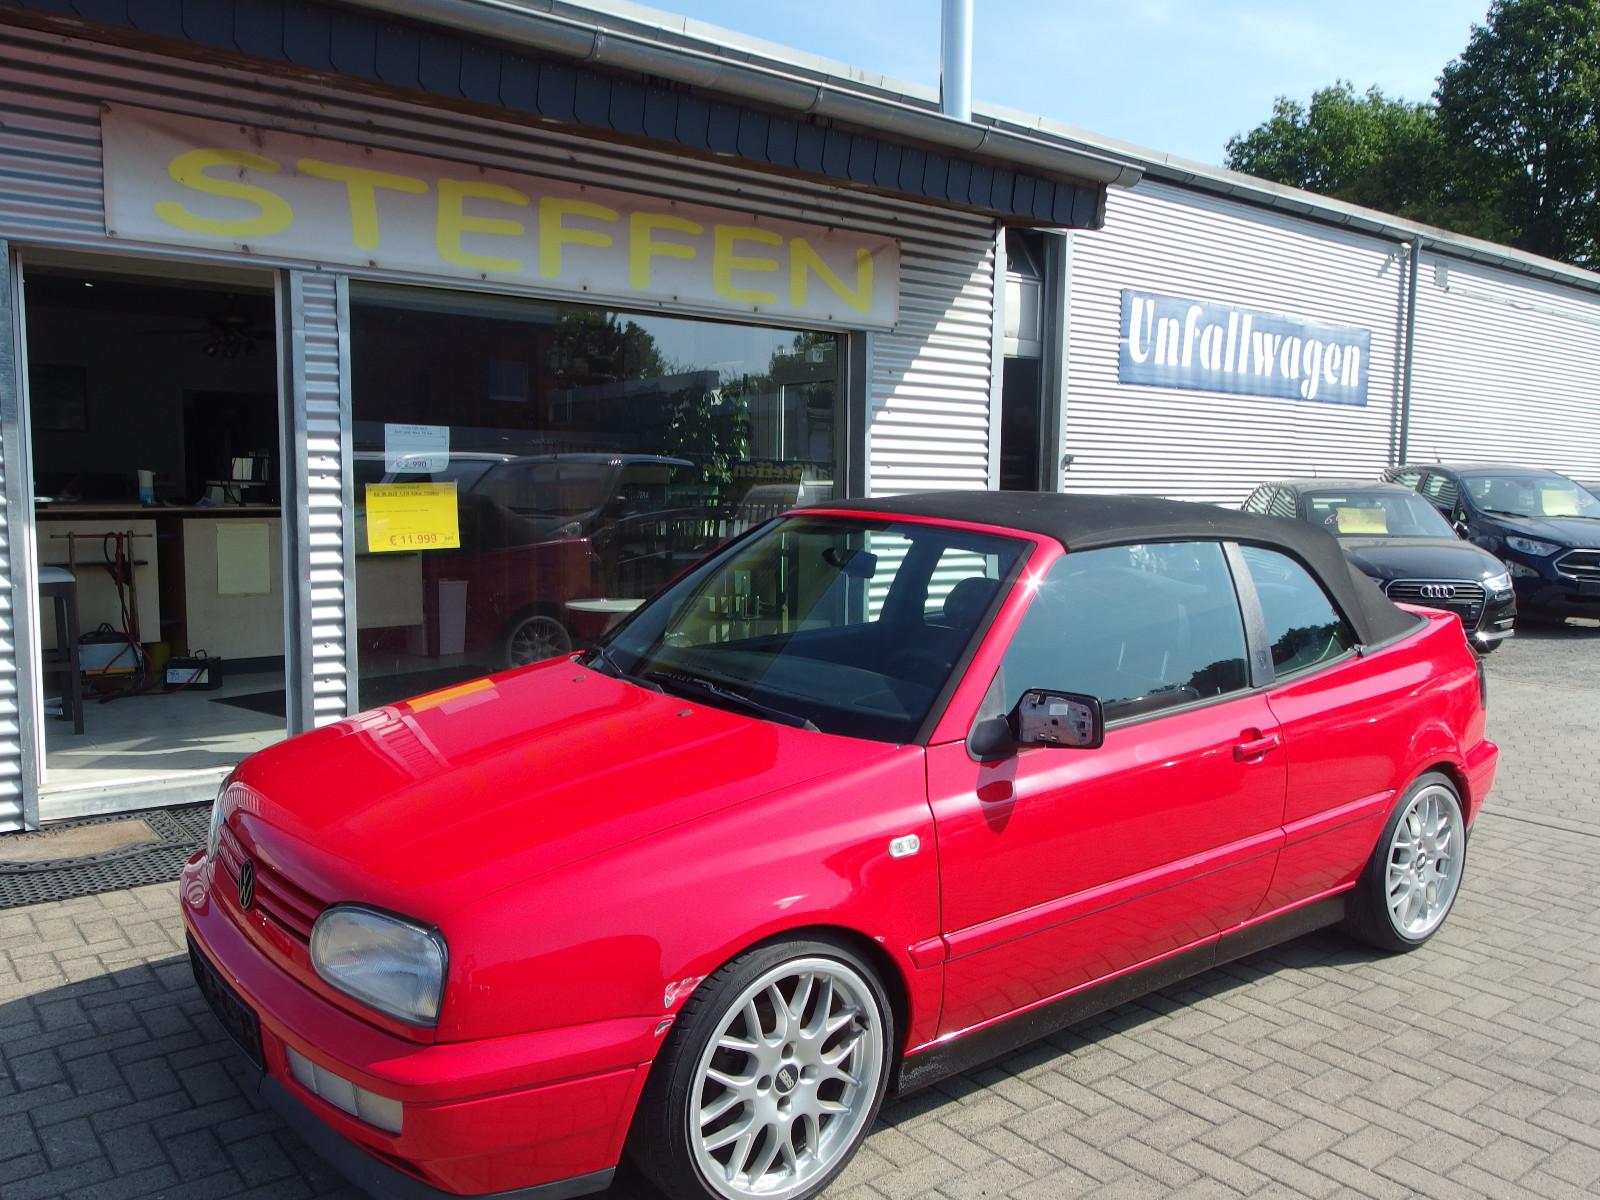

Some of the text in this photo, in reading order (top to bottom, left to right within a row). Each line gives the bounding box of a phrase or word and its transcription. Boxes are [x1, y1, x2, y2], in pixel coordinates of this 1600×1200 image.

[153, 147, 875, 313] STEFFEN
[1128, 296, 1361, 400] Unfallwagen
[389, 536, 397, 546] €
[400, 534, 437, 545] 11.999
[778, 1068, 795, 1090] BBS
